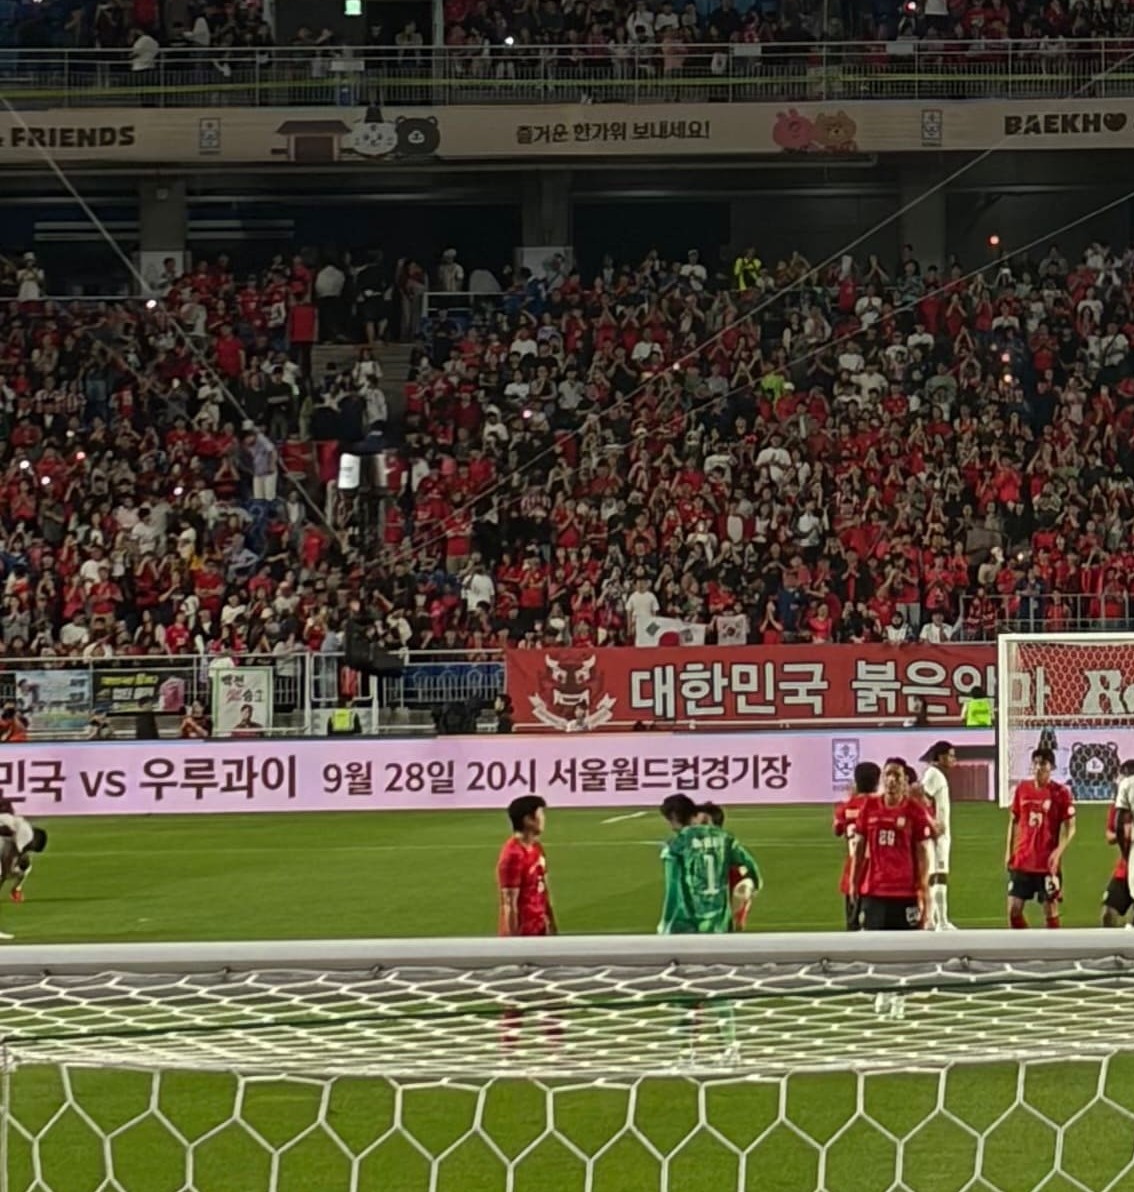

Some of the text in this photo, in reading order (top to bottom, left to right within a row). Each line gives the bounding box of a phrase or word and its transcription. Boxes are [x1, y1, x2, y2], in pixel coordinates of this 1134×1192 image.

[11, 126, 135, 147] FRIENDS
[516, 120, 710, 145] 즐거운 한가위 보내세요!
[630, 661, 828, 717] 대한민국
[140, 755, 296, 801] 우루과이
[323, 760, 373, 795] 9월
[384, 759, 455, 794] 28일
[467, 758, 536, 793] 20시
[549, 756, 792, 793] 서울월드컵경기장
